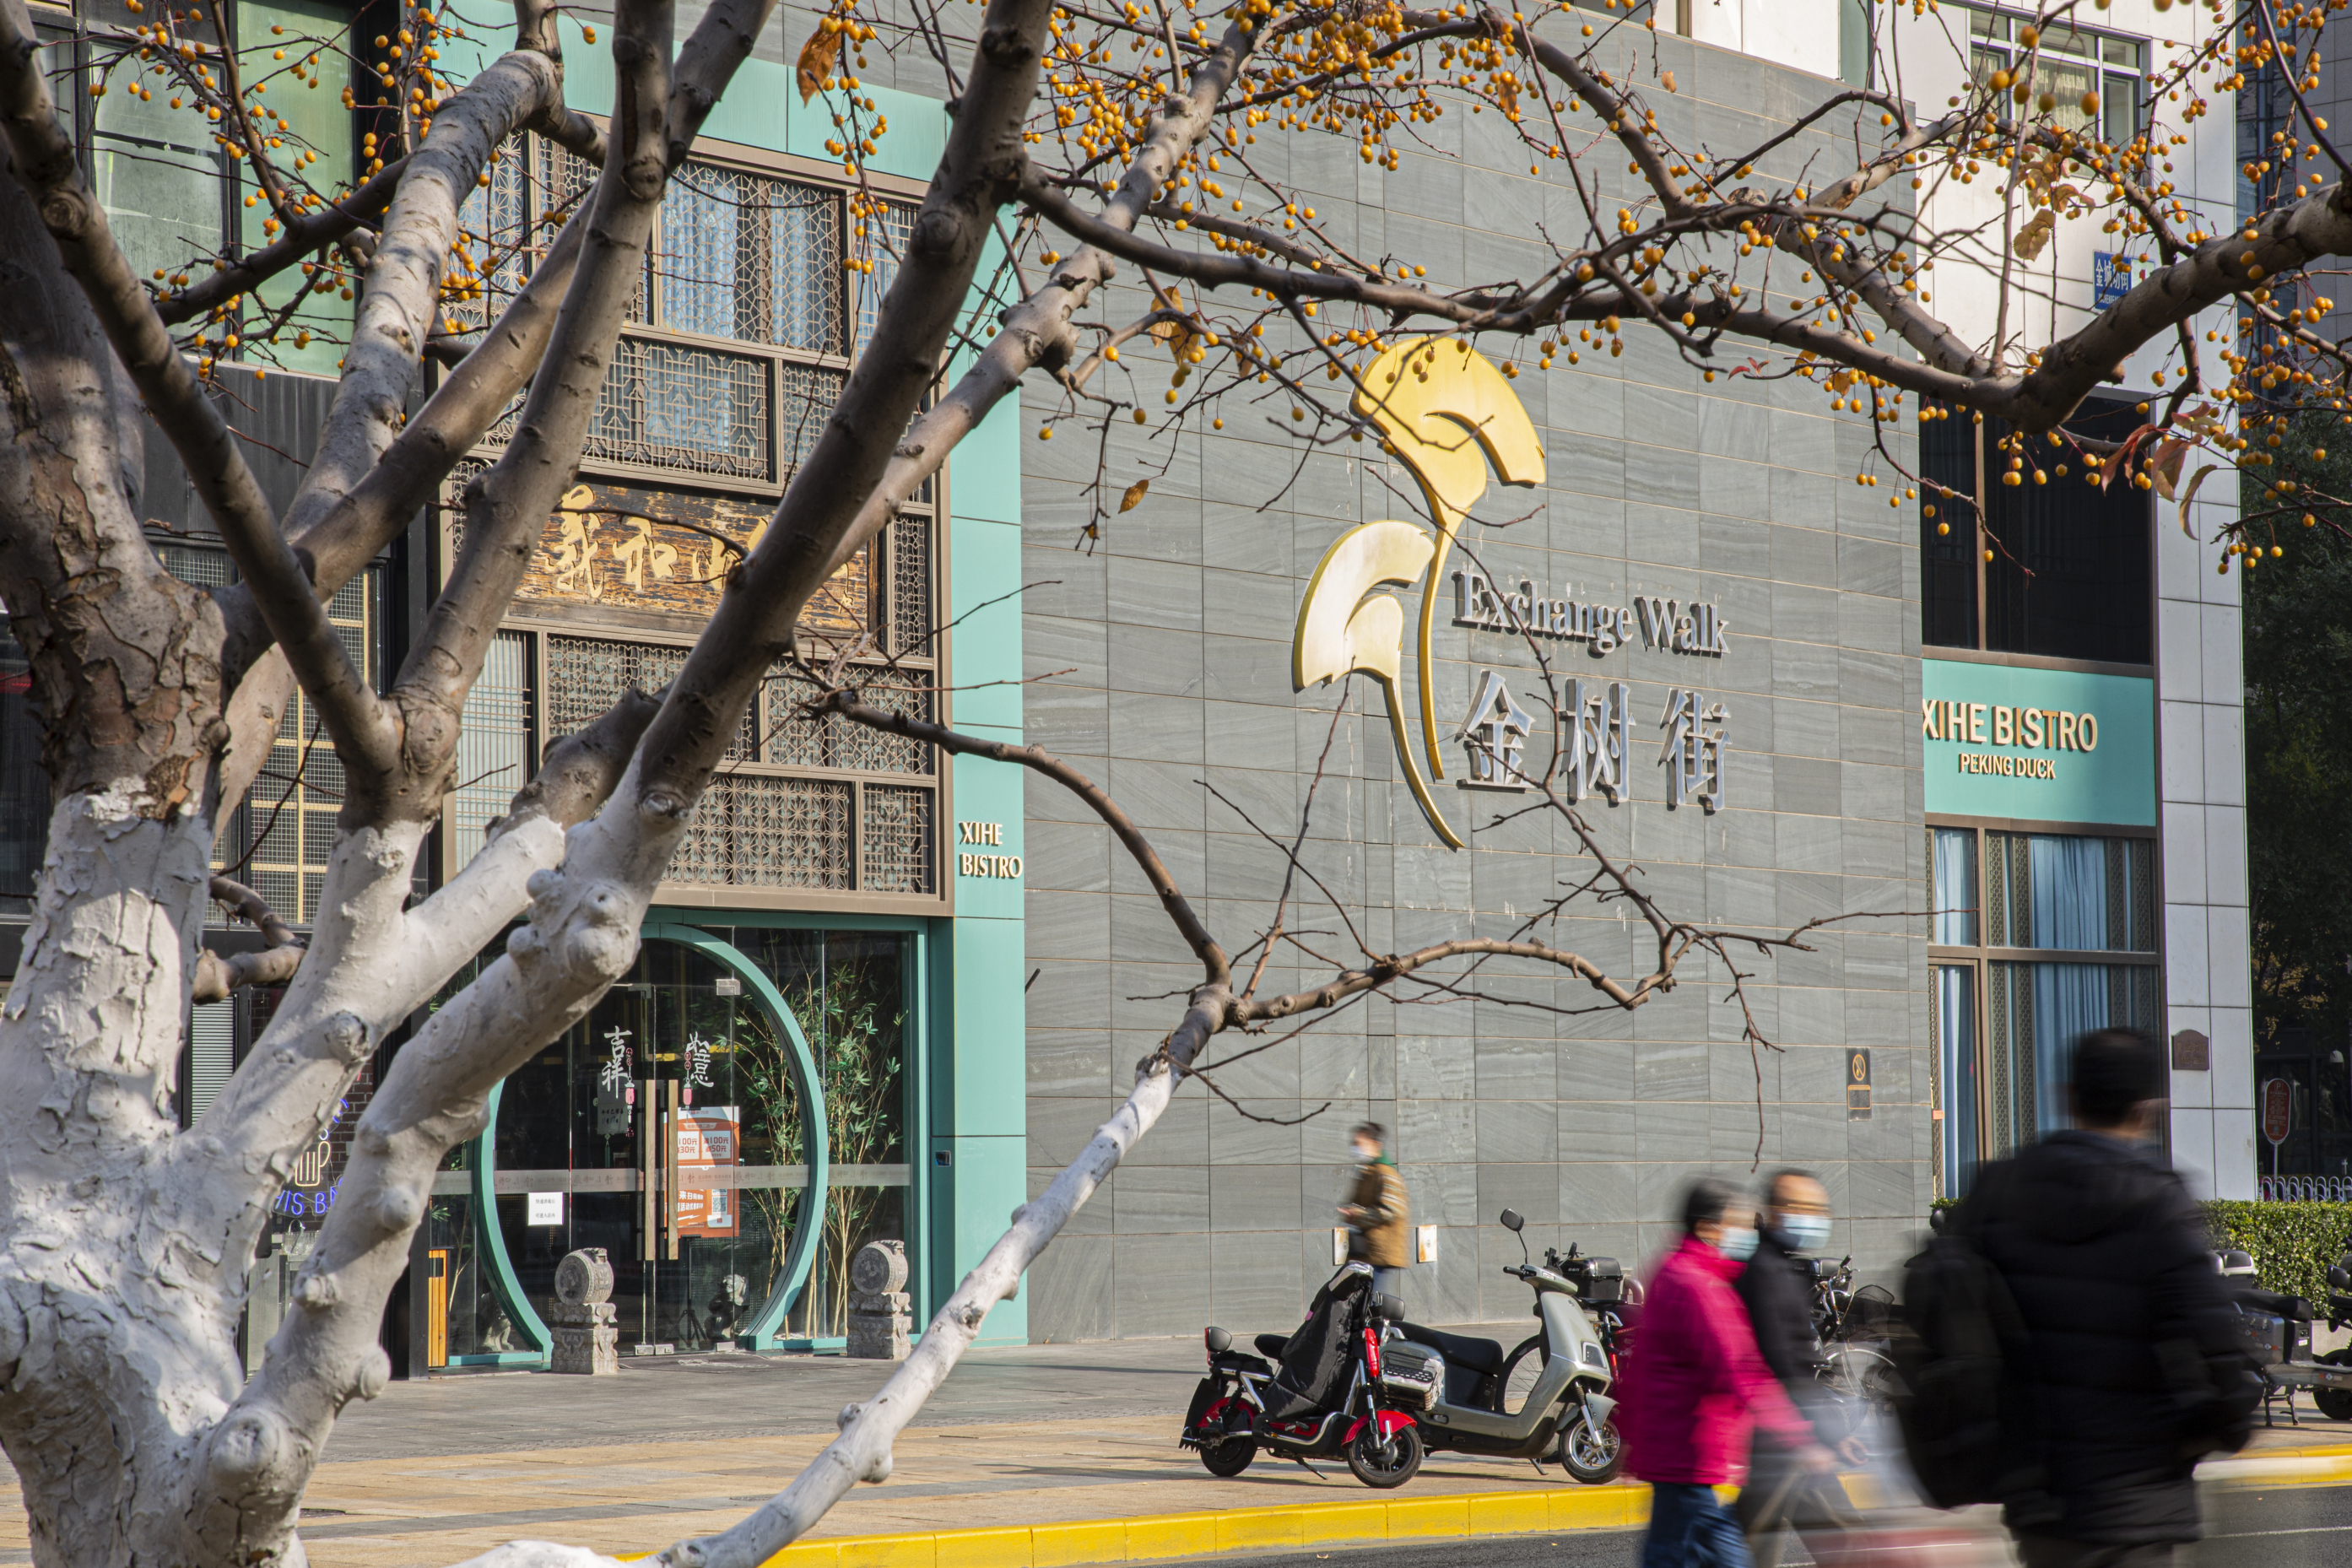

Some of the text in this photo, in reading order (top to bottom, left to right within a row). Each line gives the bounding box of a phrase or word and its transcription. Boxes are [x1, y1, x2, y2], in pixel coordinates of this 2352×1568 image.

[1452, 570, 1732, 654] Exchange Walk
[1454, 669, 1733, 812] 金树街
[1922, 699, 2099, 753] XIHE BISTRO
[1959, 753, 2056, 779] PEKING DUCK
[959, 821, 1003, 846] XIHE
[959, 852, 1024, 879] BISTRO
[602, 1025, 633, 1099] 吉祥
